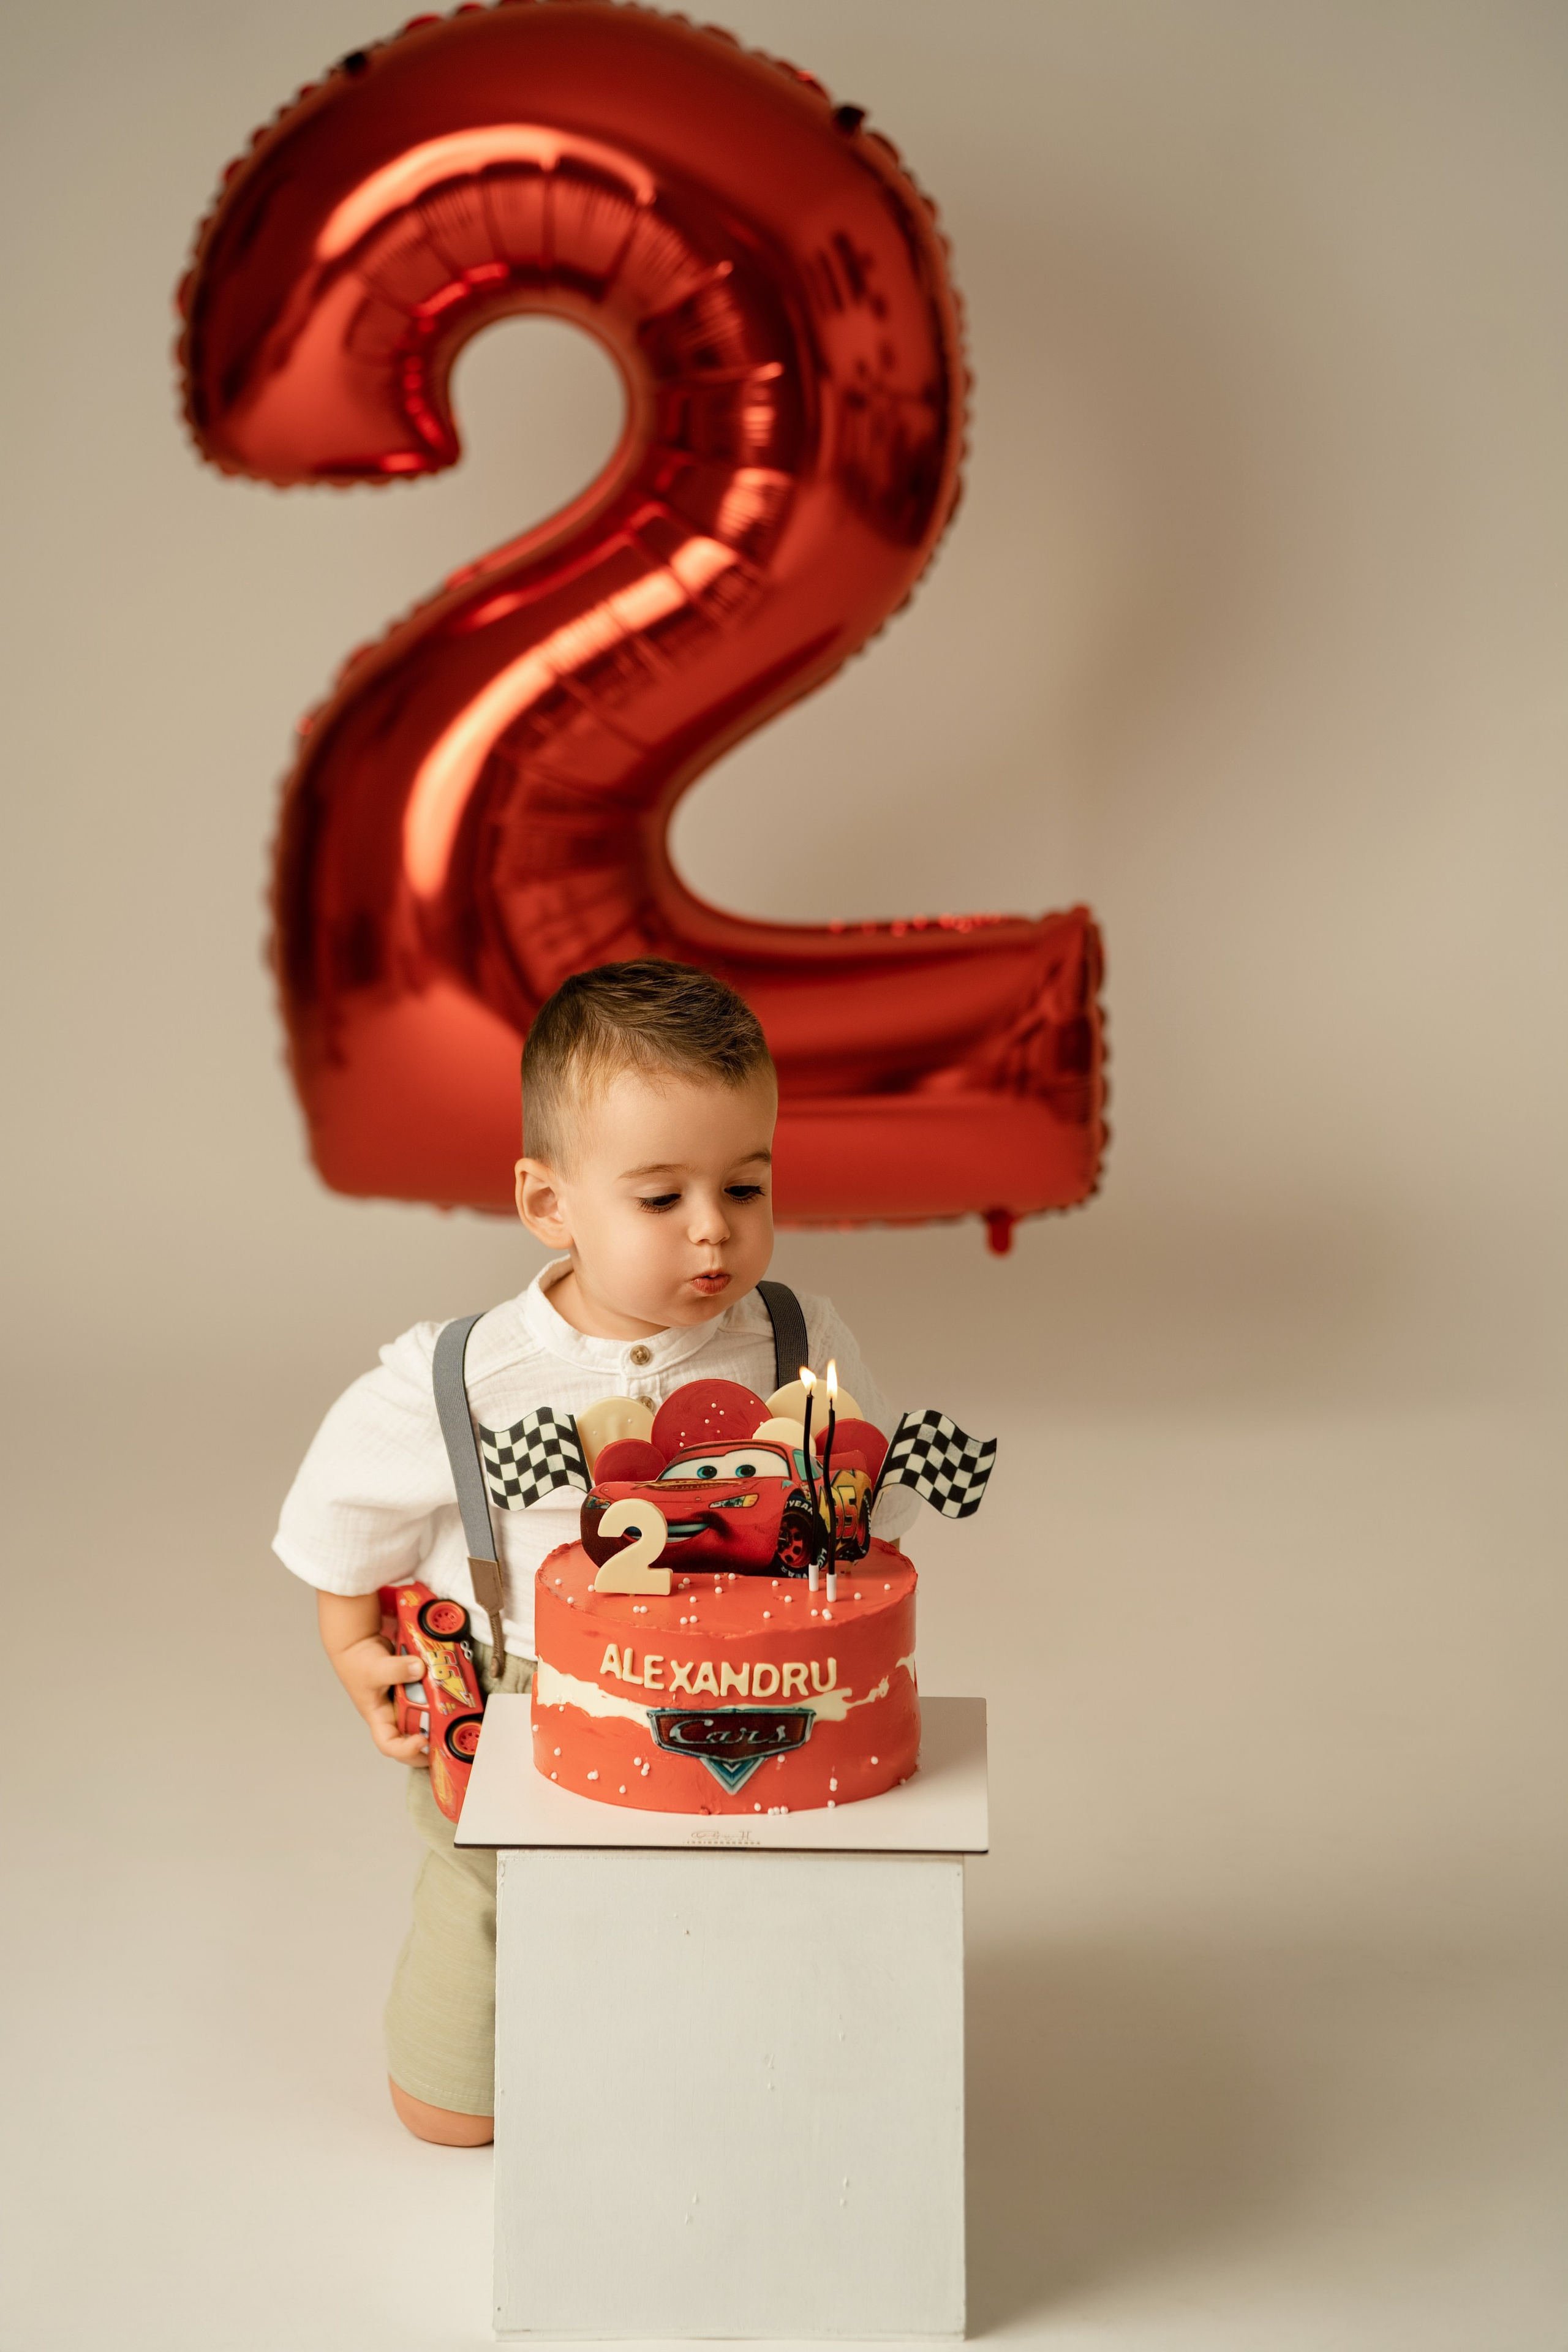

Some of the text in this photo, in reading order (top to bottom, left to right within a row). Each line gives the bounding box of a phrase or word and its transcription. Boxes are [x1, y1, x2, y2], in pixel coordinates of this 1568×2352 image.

[173, 0, 1114, 1224] 2
[594, 1498, 673, 1596] 2
[427, 1649, 461, 1680] 95
[600, 1643, 837, 1698] ALEXANDRU
[669, 1719, 792, 1745] Cars
